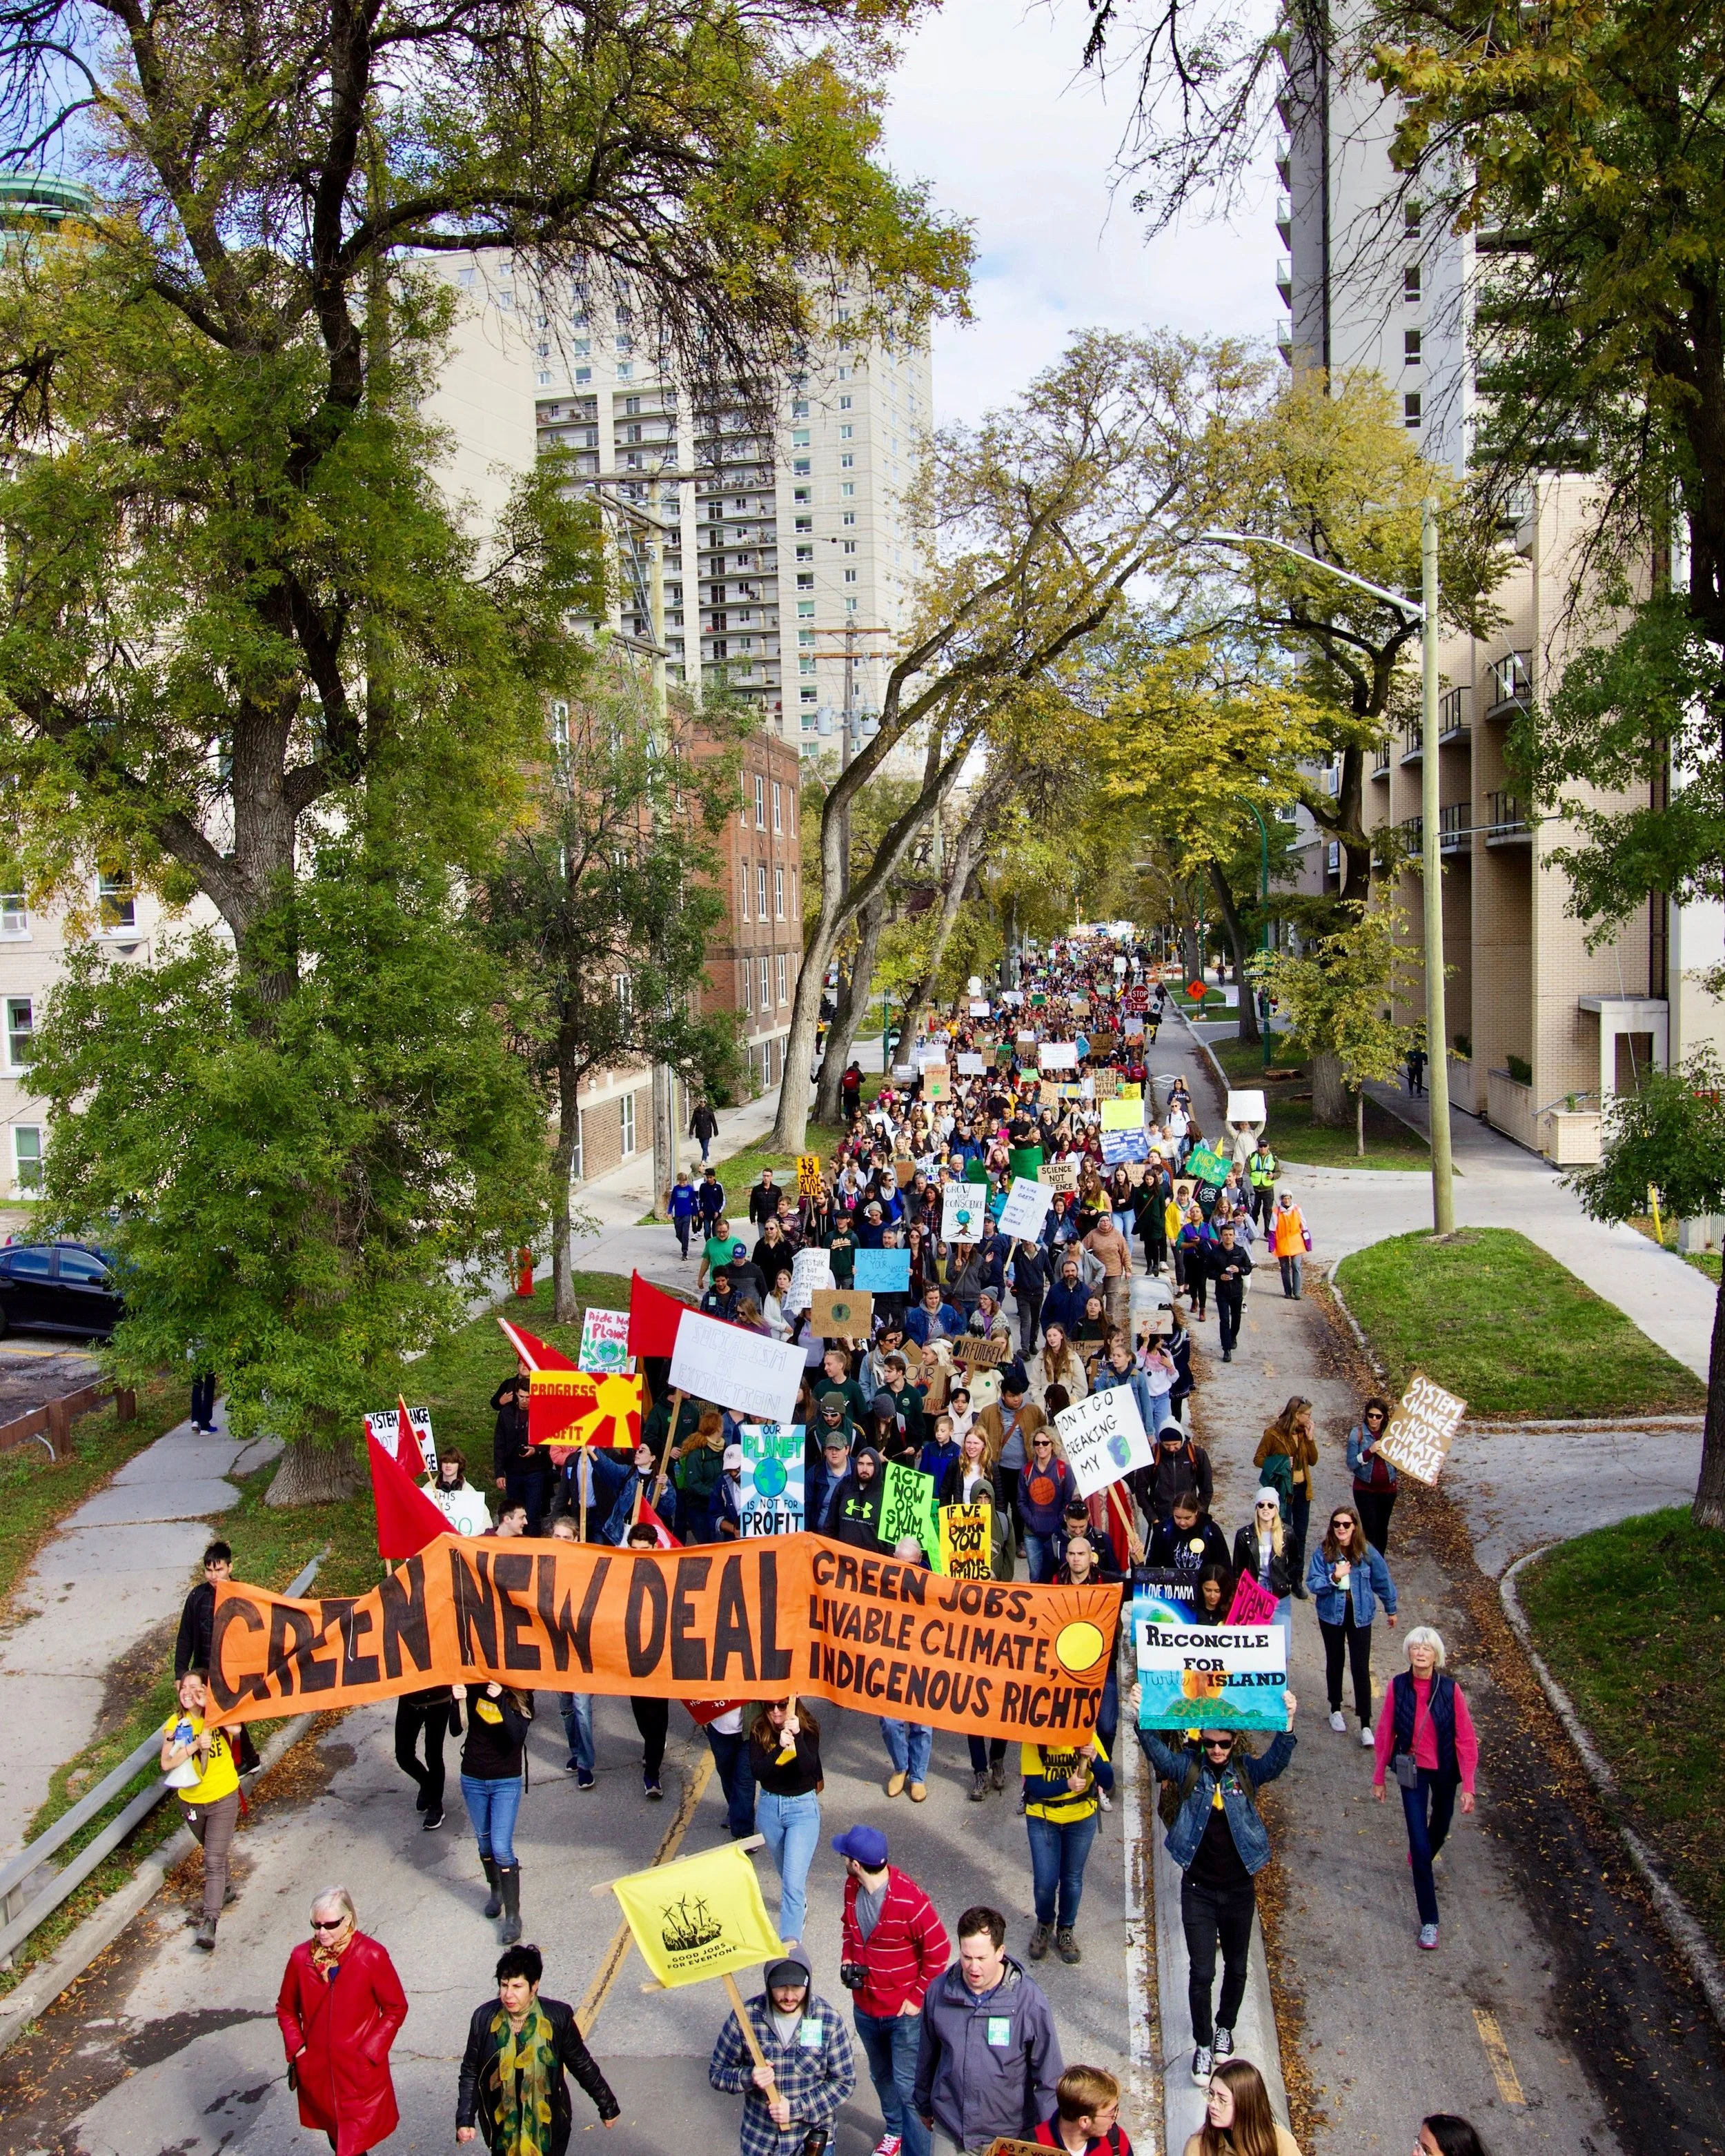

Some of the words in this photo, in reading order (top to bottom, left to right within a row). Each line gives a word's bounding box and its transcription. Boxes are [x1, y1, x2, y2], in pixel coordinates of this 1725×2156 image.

[1195, 1151, 1216, 1167] NO
[800, 1174, 819, 1184] STAY
[800, 1183, 821, 1194] ALIVE
[946, 1185, 971, 1194] GROW
[1018, 1193, 1035, 1202] GRETA
[945, 1200, 983, 1209] CONSCIENCE
[1004, 1217, 1021, 1226] SCIENCE
[813, 1259, 825, 1267] talk
[860, 1250, 887, 1260] RAISE
[869, 1260, 888, 1269] YOUR
[806, 1274, 825, 1283] comes
[589, 1312, 612, 1324] Aide
[691, 1322, 787, 1372] SOCIALISM
[969, 1343, 1001, 1365] FUTURE!
[715, 1354, 736, 1378] OR
[905, 1365, 934, 1380] OUR
[531, 1384, 596, 1397] PROGRESS
[678, 1363, 781, 1416] EXTINCTION
[1410, 1376, 1463, 1420] SYSTEM
[1058, 1405, 1086, 1435] DON'T
[1093, 1392, 1113, 1411] GO
[1403, 1394, 1457, 1438] CHANGE
[762, 1425, 781, 1435] OUR
[1066, 1414, 1118, 1460] BREAKING
[1406, 1418, 1439, 1444] NOT
[743, 1435, 805, 1458] PLANET
[1390, 1421, 1446, 1467] CLIMATE
[1080, 1454, 1100, 1478] MY
[1381, 1436, 1438, 1483] CHANGE
[890, 1466, 925, 1488] ACT
[433, 1491, 455, 1501] THIS
[894, 1483, 925, 1504] NOW
[747, 1501, 755, 1510] IS
[760, 1499, 780, 1510] NOT
[784, 1500, 798, 1509] FOR
[895, 1499, 914, 1514] OR
[947, 1506, 956, 1520] IF
[961, 1505, 980, 1518] WE
[742, 1511, 803, 1537] PROFIT
[885, 1508, 923, 1536] SWIM
[949, 1532, 981, 1552] YOU
[812, 1550, 929, 1606] GREEN
[938, 1581, 1038, 1631] JOBS,
[1142, 1583, 1163, 1599] LOVE
[1163, 1584, 1173, 1600] YO
[1173, 1585, 1194, 1601] MAMA
[1237, 1576, 1275, 1620] STAND
[208, 1553, 433, 1712] GREEN
[448, 1548, 612, 1674] NEW
[624, 1551, 793, 1681] DEAL
[809, 1594, 915, 1652] LIVABLE
[920, 1619, 1059, 1681] CLIMATE,
[1183, 1658, 1225, 1671] FOR
[809, 1641, 993, 1718] INDIGENOUS
[1000, 1681, 1101, 1729] RIGHTS
[1139, 1671, 1190, 1686] Turtle
[1208, 1672, 1286, 1687] ISLAND
[672, 1952, 699, 1963] GOOD
[703, 1942, 726, 1955] JOBS
[689, 1944, 738, 1966] EVERYONE
[1000, 2142, 1015, 2152] AS
